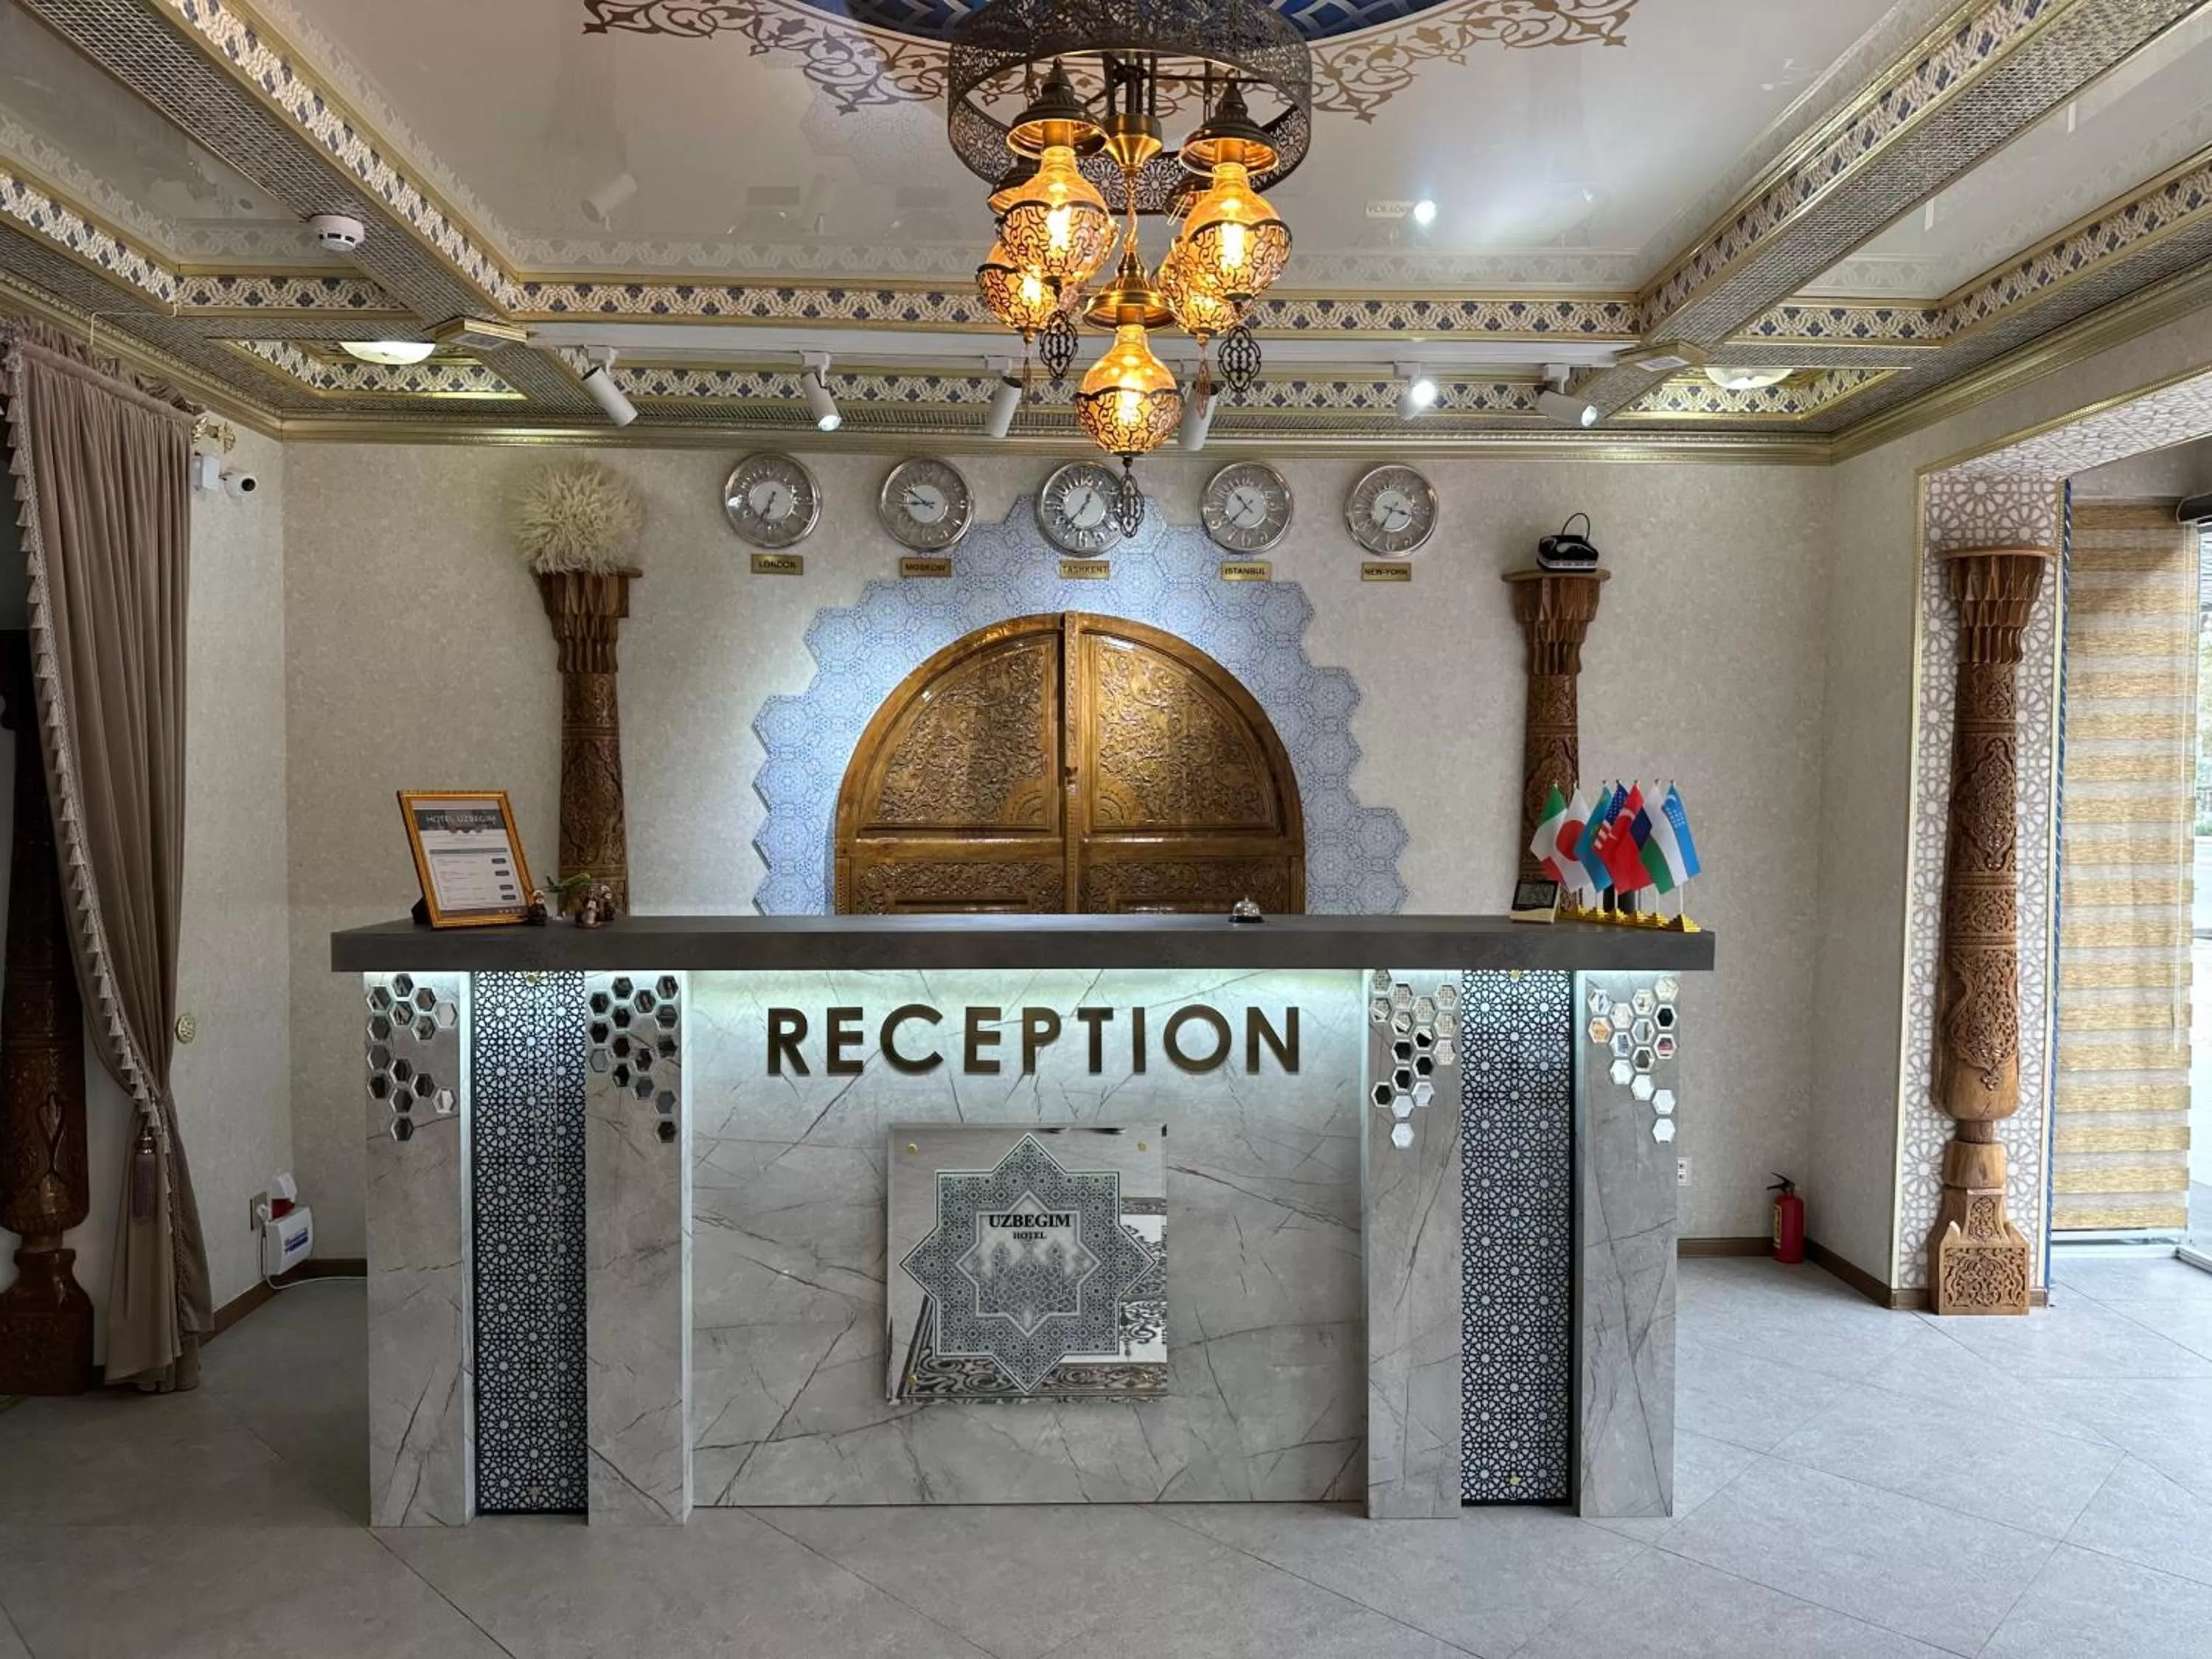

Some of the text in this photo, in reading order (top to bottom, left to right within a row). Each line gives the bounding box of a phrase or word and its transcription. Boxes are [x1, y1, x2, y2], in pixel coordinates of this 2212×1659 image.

[1062, 566, 1110, 574] TASHKENT
[1225, 566, 1266, 575] ISTANBUL
[767, 1004, 1300, 1075] RECEPTION
[989, 1214, 1071, 1228] UZBEGIM
[1012, 1231, 1048, 1239] HOTEL
